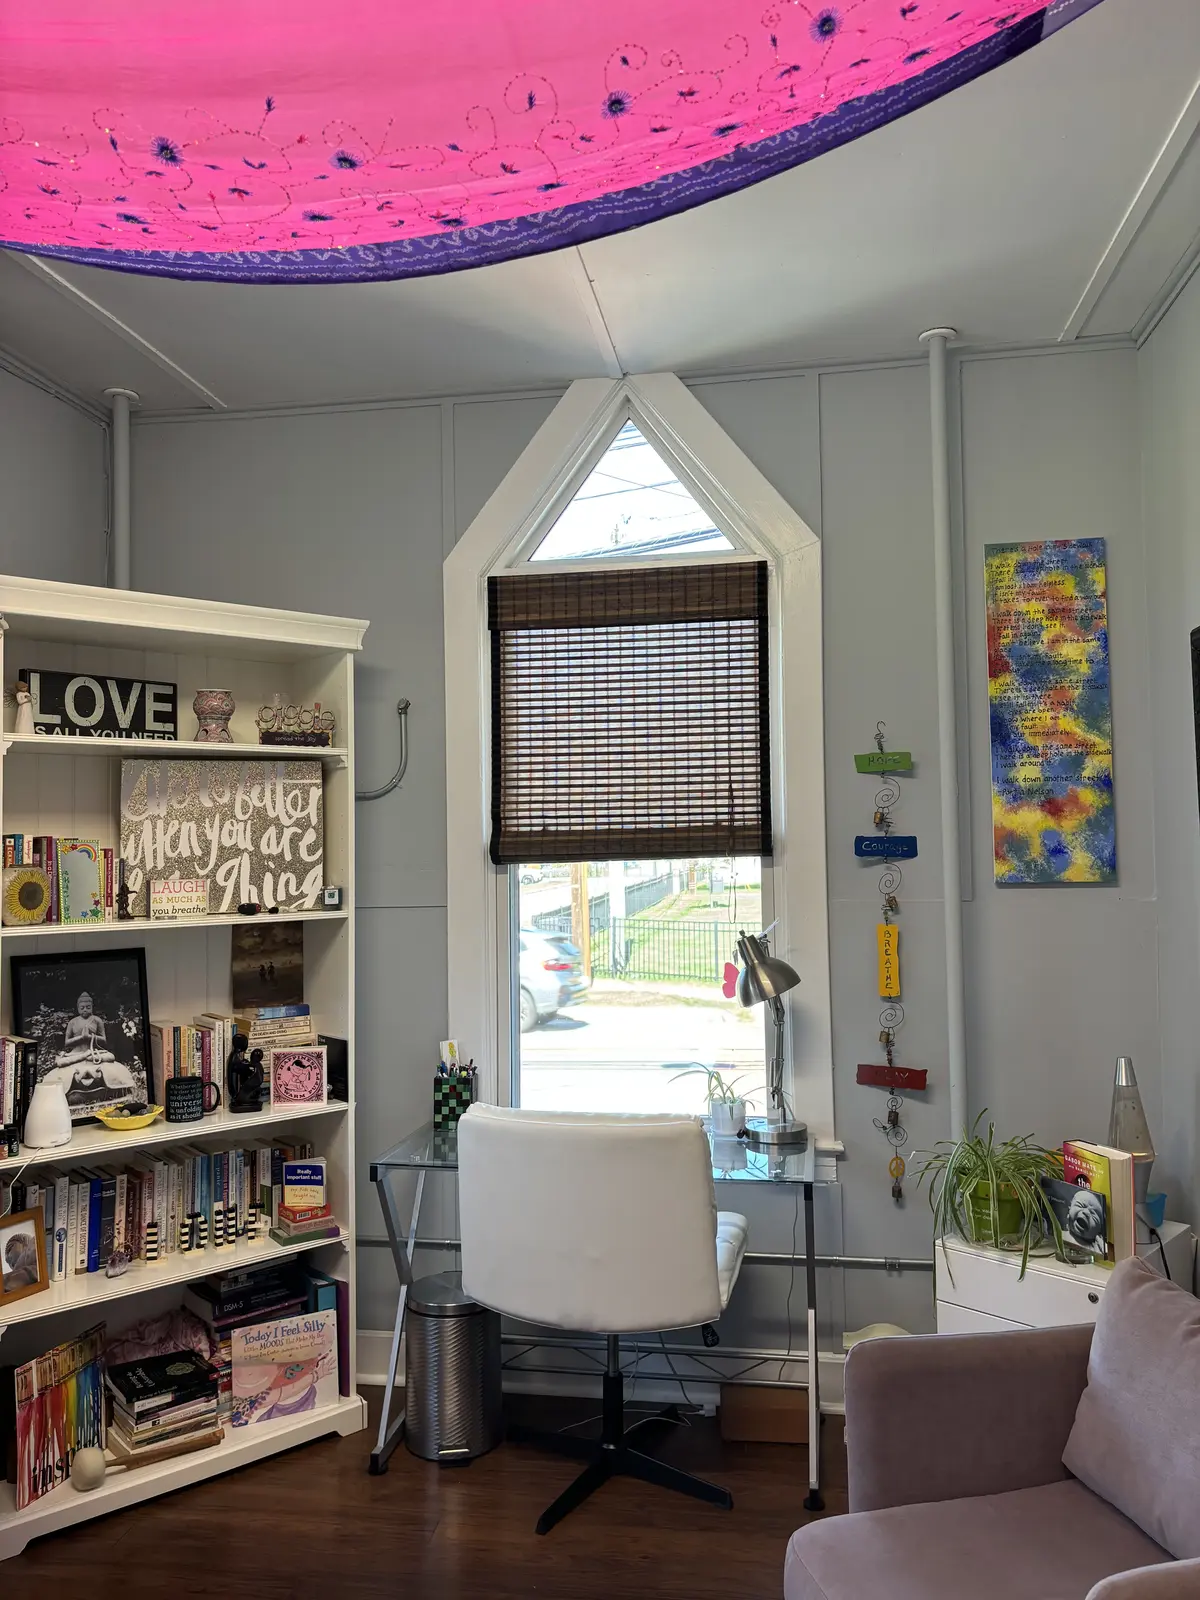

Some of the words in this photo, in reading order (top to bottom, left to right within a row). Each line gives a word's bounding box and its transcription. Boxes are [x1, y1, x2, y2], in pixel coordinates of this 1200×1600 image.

[30, 672, 174, 732] LOVE
[868, 756, 901, 767] HOPE
[1002, 776, 1018, 784] walk
[1022, 774, 1042, 782] down
[194, 814, 255, 875] you
[260, 825, 322, 862] are
[152, 880, 206, 894] LAUGH
[152, 896, 164, 904] AS
[166, 896, 192, 904] MUCH
[152, 908, 170, 917] you
[171, 904, 206, 914] breathe
[883, 930, 894, 990] BREATHE
[280, 1055, 318, 1070] HAPPINESS
[277, 1073, 282, 1081] IS
[284, 1090, 306, 1098] WARM
[308, 1072, 320, 1094] PUPPY
[1065, 1154, 1080, 1166] GABOR
[1078, 1178, 1091, 1190] the
[224, 1300, 244, 1312] DSM-5
[240, 1330, 272, 1346] Today
[273, 1327, 278, 1339] I
[280, 1323, 301, 1338] Feel
[302, 1320, 326, 1332] Silly
[260, 1338, 284, 1350] MOODS
